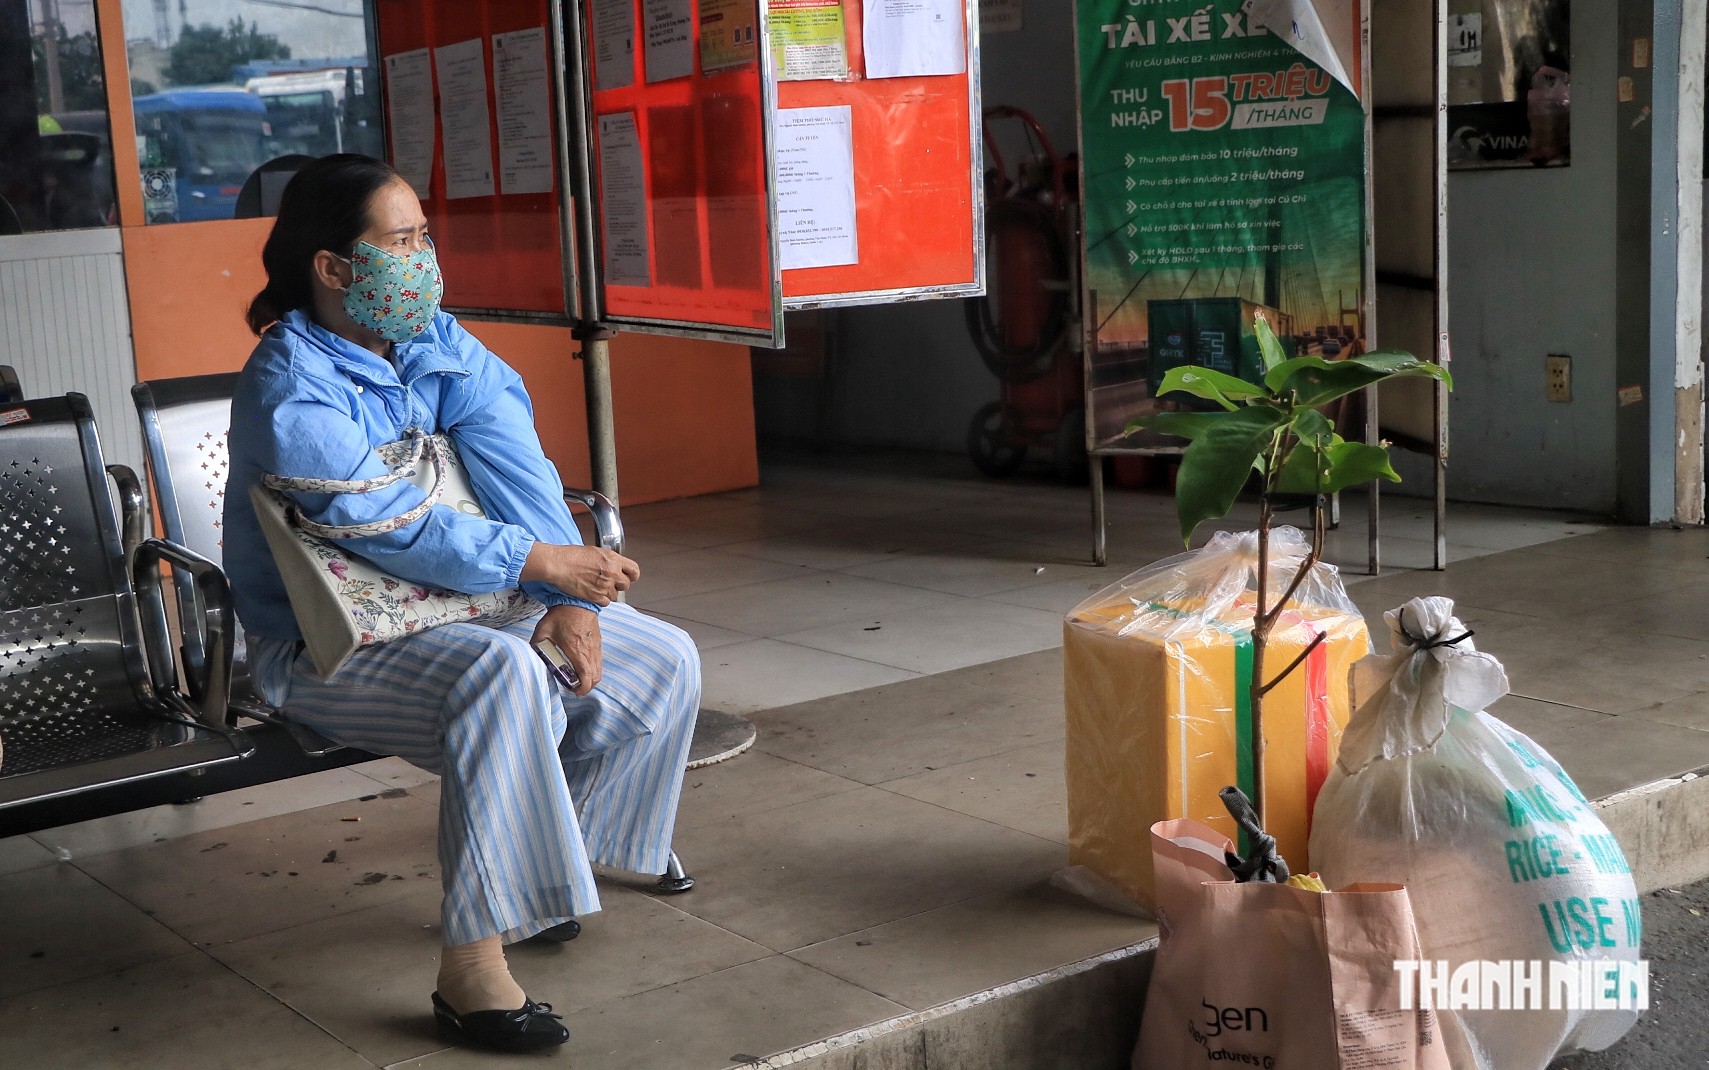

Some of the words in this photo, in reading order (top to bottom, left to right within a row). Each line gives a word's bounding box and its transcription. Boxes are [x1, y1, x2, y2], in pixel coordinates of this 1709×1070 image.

[1101, 15, 1156, 49] TÀI
[1166, 4, 1215, 43] XẾ
[1191, 55, 1203, 63] B2
[1209, 53, 1233, 62] KINH
[1230, 62, 1331, 103] TRIỆU
[1110, 87, 1148, 104] THU
[1161, 76, 1231, 132] 15
[1111, 106, 1163, 130] NHẬP
[1246, 104, 1313, 125] /THÁNG
[1220, 150, 1231, 158] 10
[1233, 146, 1298, 159] triệu/tháng
[1230, 172, 1237, 181] 2
[1240, 169, 1304, 182] triệu/tháng
[1168, 223, 1190, 231] 500K
[1191, 222, 1205, 231] khi
[1247, 244, 1270, 252] tham
[1272, 244, 1286, 253] gia
[1504, 832, 1570, 883] RICE
[1539, 896, 1616, 954] USE
